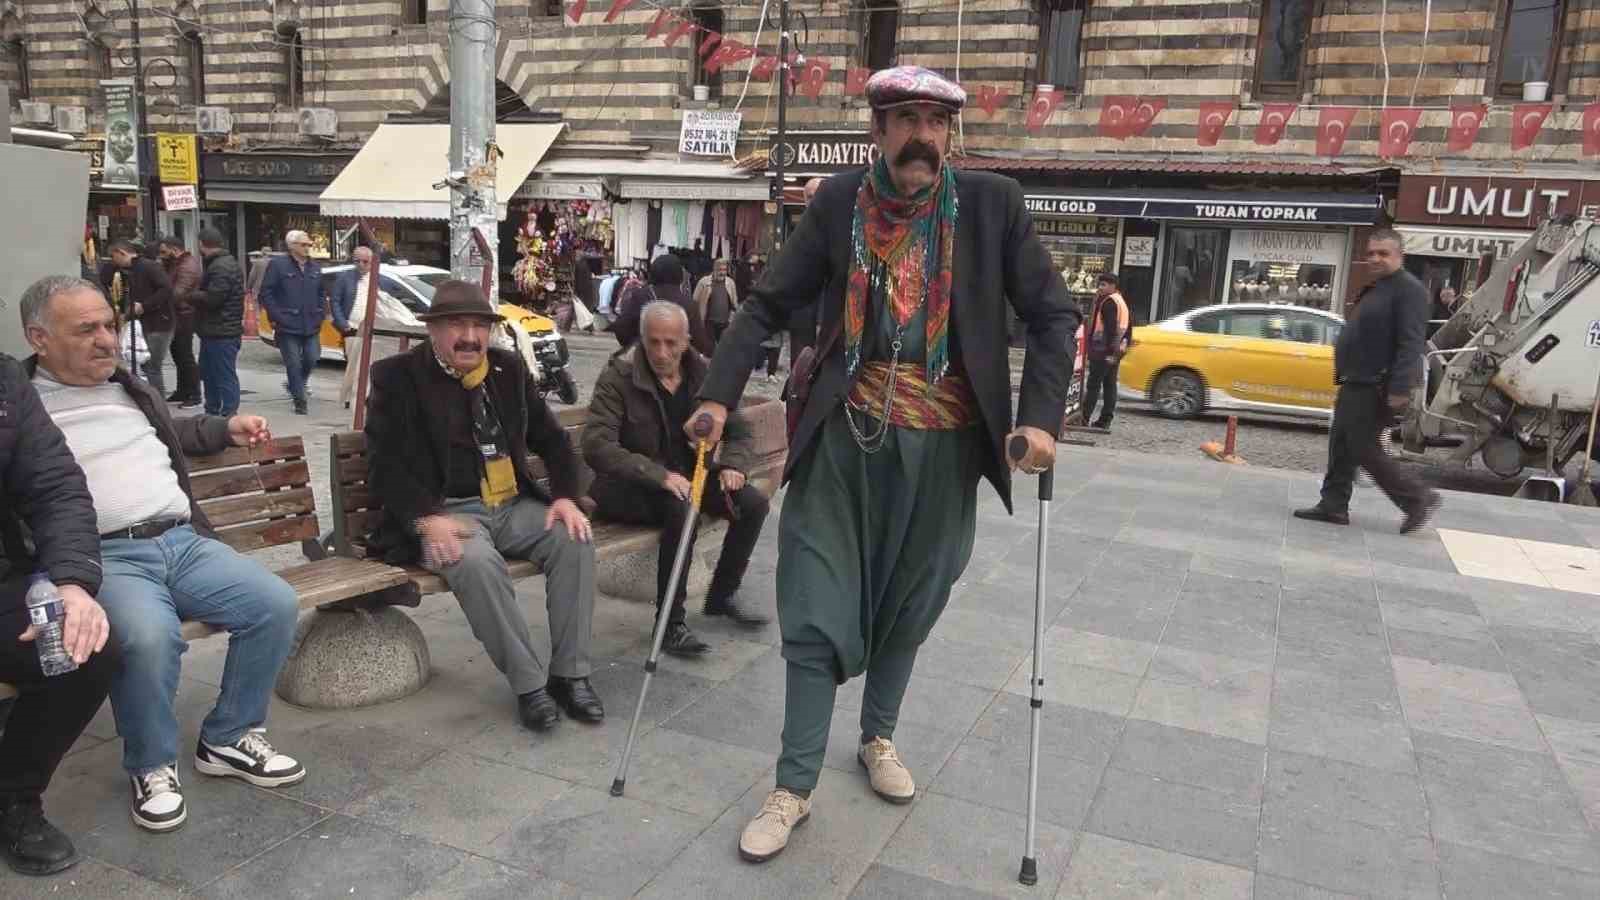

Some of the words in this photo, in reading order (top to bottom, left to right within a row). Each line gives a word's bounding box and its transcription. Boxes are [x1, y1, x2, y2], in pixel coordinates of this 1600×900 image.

[1059, 200, 1096, 213] GOLD
[1426, 185, 1570, 218] UMUT
[1195, 205, 1249, 218] TURAN
[1252, 207, 1319, 220] TOPRAK
[1432, 235, 1514, 256] UMUT
